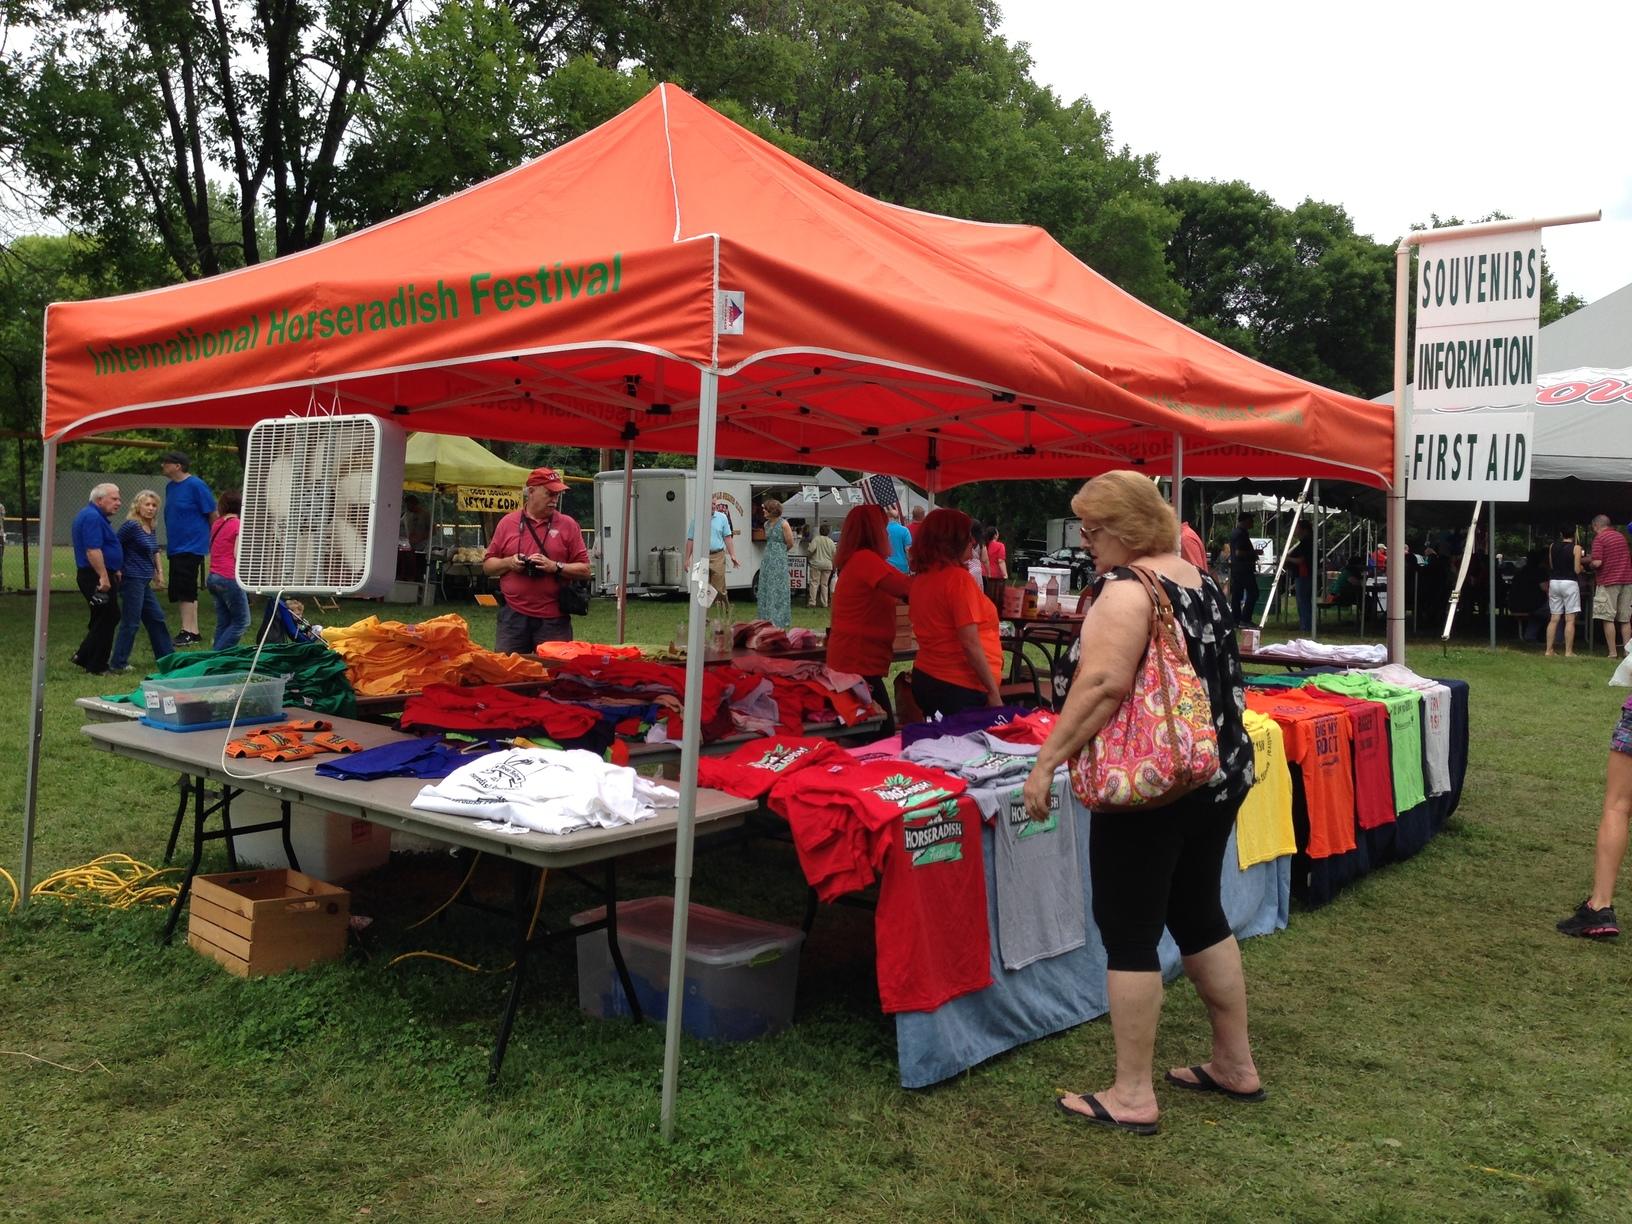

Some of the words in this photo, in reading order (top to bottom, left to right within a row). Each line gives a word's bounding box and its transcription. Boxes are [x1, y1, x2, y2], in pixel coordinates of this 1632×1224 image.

[1421, 248, 1536, 309] SOUVENIRS
[88, 314, 260, 376] International
[266, 279, 459, 346] Horseradish
[470, 252, 623, 315] Festival
[1418, 335, 1533, 391] INFORMATION
[1413, 433, 1478, 482] FIRST
[1486, 433, 1527, 481] AID
[463, 497, 494, 509] KETTLE
[497, 498, 520, 510] CORN
[788, 569, 805, 578] NEL
[905, 822, 963, 848] HORSERADISH
